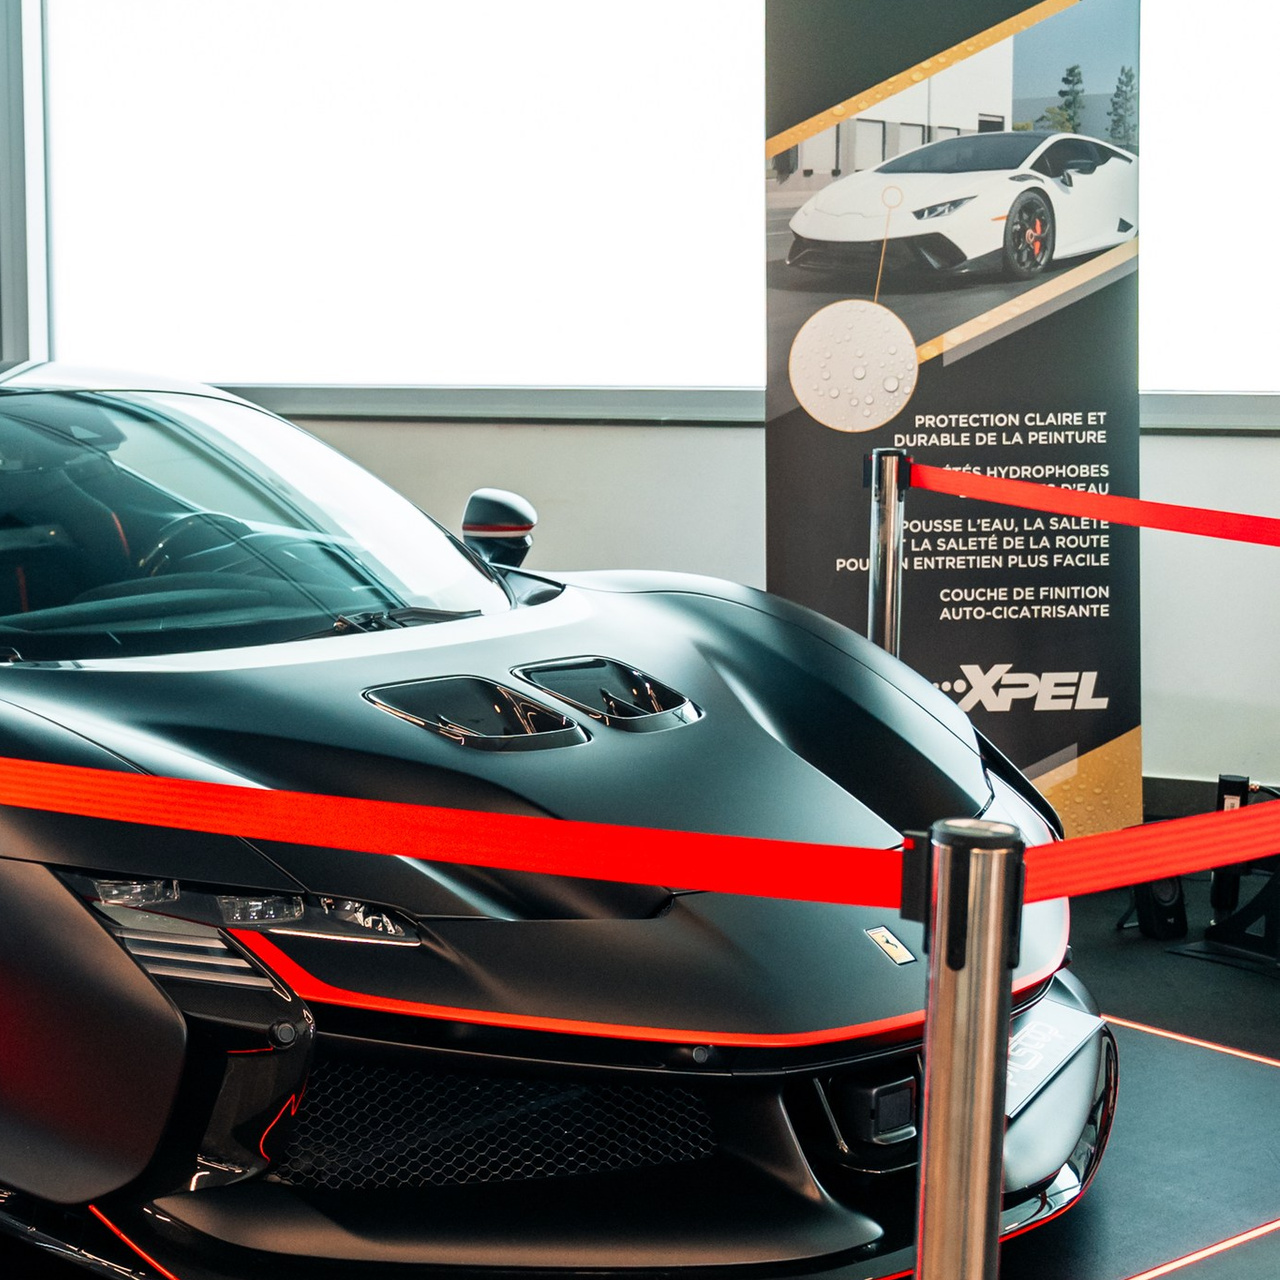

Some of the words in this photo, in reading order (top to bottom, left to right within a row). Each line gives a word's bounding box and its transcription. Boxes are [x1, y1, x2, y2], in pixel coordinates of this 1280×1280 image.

[915, 413, 1020, 428] PROTECTION
[1024, 412, 1083, 427] CLAIRE
[1087, 411, 1107, 425] ET
[894, 433, 970, 447] DURABLE
[975, 432, 997, 446] DE
[1002, 432, 1023, 445] LA
[1028, 430, 1107, 445] PEINTURE
[986, 464, 1109, 479] HYDROPHOBES
[903, 519, 963, 533] POUSSE
[967, 519, 1019, 533] L'EAU,
[1023, 517, 1046, 531] LA
[911, 538, 932, 551] LA
[936, 534, 998, 550] SALETÉ
[1003, 536, 1025, 550] DE
[1030, 536, 1051, 549] LA
[1055, 535, 1109, 549] ROUTE
[836, 558, 870, 571] POU
[913, 555, 1003, 570] ENTRETIEN
[1008, 554, 1049, 568] PLUS
[1053, 553, 1109, 567] FACILE
[939, 587, 1008, 602] COUCHE
[1013, 587, 1035, 601] DE
[1039, 585, 1110, 600] FINITION
[939, 604, 1110, 620] AUTO-CICATRISANTE
[957, 663, 1109, 712] XPEL
